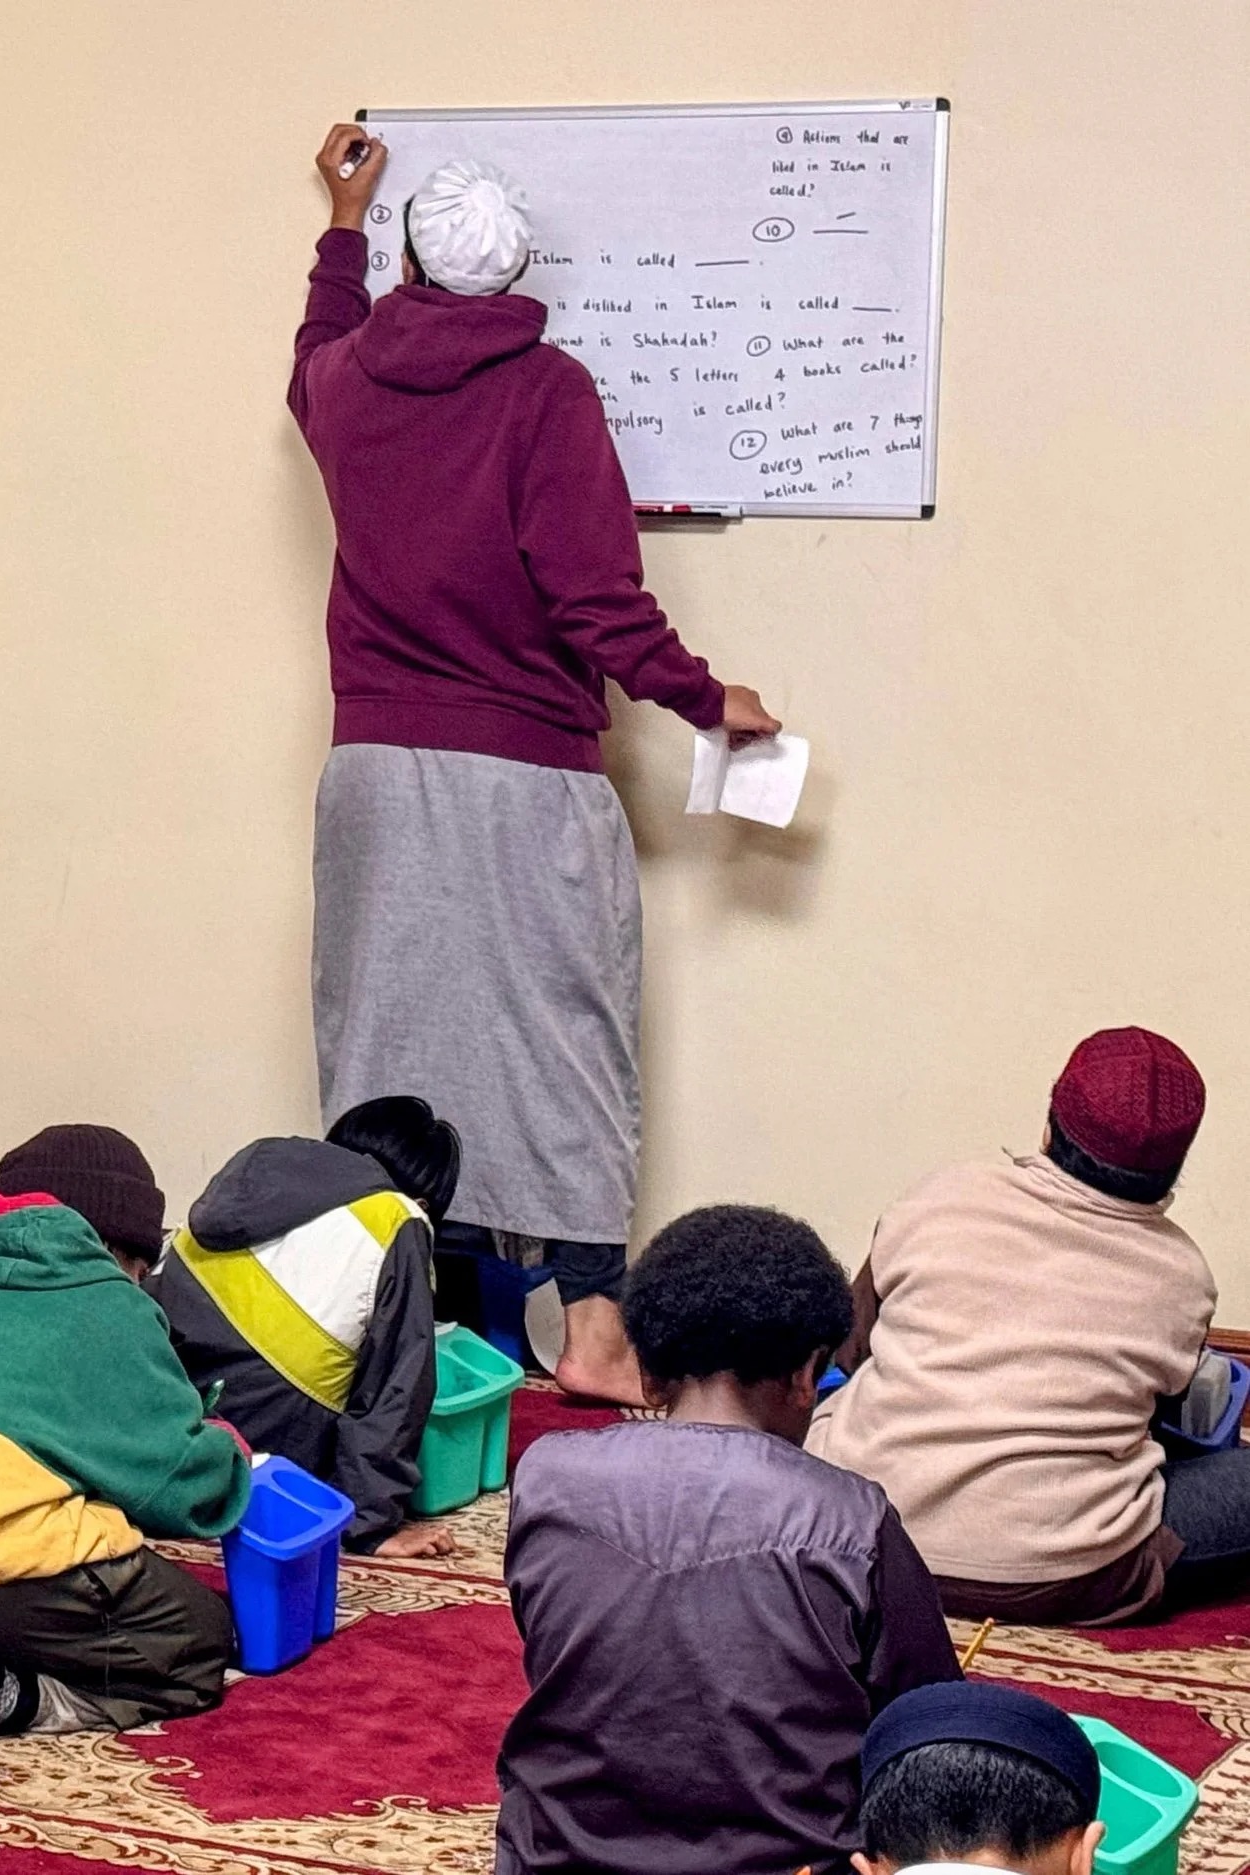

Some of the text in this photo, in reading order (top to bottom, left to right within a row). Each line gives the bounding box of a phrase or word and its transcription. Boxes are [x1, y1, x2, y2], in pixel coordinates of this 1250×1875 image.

[893, 136, 908, 145] are
[807, 159, 818, 171] in
[830, 160, 865, 172] Islam
[880, 157, 891, 172] is
[530, 250, 675, 268] Islam is called
[557, 295, 838, 312] is disliked in Islam is called
[601, 332, 611, 346] is
[633, 331, 717, 348] Shahadah?
[783, 337, 823, 350] What
[842, 337, 864, 346] are
[882, 332, 904, 344] the
[630, 370, 650, 385] the
[696, 368, 737, 382] letters
[775, 354, 916, 381] 4 books called?
[694, 403, 706, 416] is
[725, 392, 785, 415] called?
[781, 422, 817, 440] What
[834, 422, 853, 432] are
[870, 415, 879, 430] 7
[759, 458, 802, 475] every
[818, 446, 870, 463] muslim
[832, 472, 852, 490] in?
